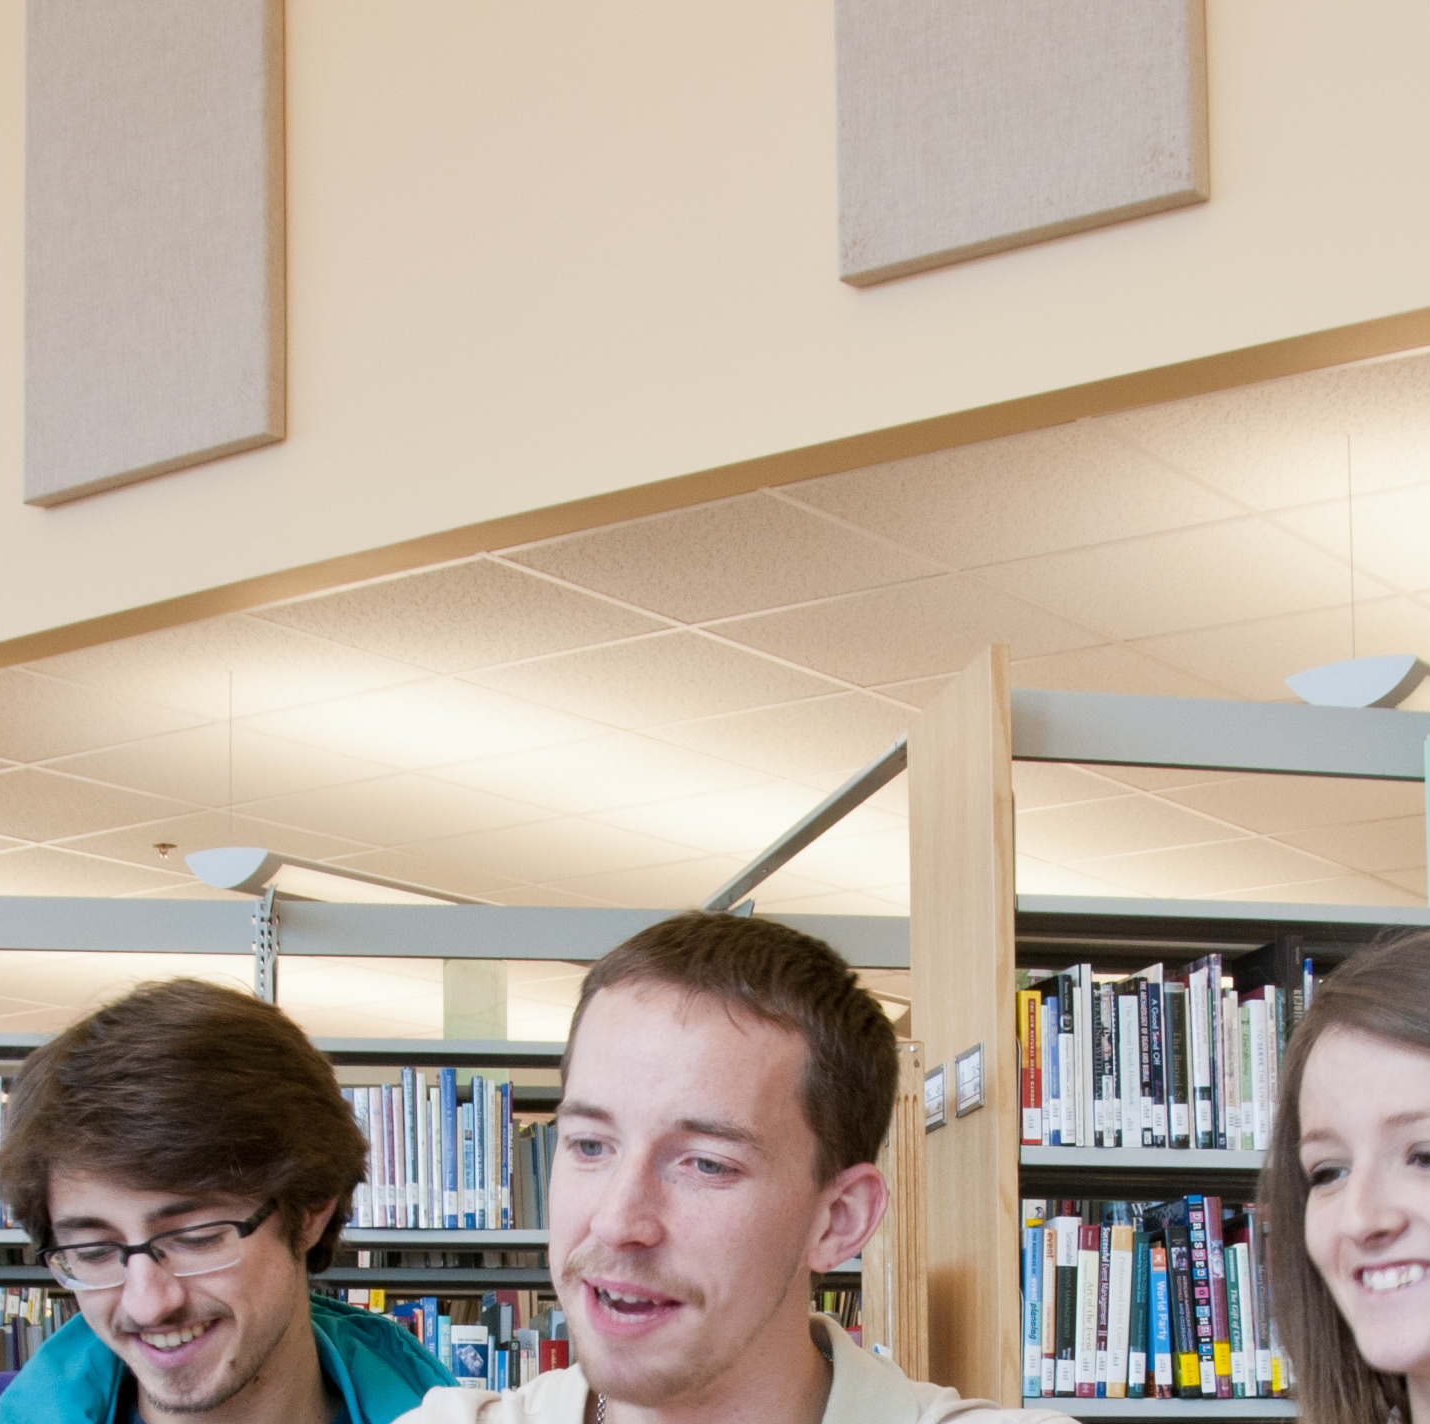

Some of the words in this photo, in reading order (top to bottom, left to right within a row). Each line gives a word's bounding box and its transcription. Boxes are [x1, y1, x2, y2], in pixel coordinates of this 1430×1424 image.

[1126, 1005, 1134, 1018] The
[1126, 1020, 1134, 1045] Natural
[1173, 1030, 1181, 1050] The
[1257, 1030, 1263, 1040] TO
[1174, 1054, 1183, 1087] Buried
[1128, 1070, 1136, 1105] Handbook
[1046, 1232, 1054, 1258] event
[1065, 1231, 1073, 1264] Sustainable
[1102, 1227, 1110, 1262] Successful
[1064, 1268, 1072, 1287] EVENT
[1101, 1263, 1109, 1282] Event
[1256, 1265, 1264, 1285] Merry
[1086, 1282, 1095, 1296] Art
[1157, 1281, 1165, 1311] World
[1230, 1289, 1238, 1303] The
[1087, 1298, 1095, 1307] of
[1099, 1283, 1109, 1325] Management
[1231, 1305, 1239, 1319] Gift
[1029, 1303, 1038, 1340] planning
[1086, 1310, 1095, 1324] the
[1157, 1314, 1167, 1340] Party
[1085, 1327, 1093, 1351] Event
